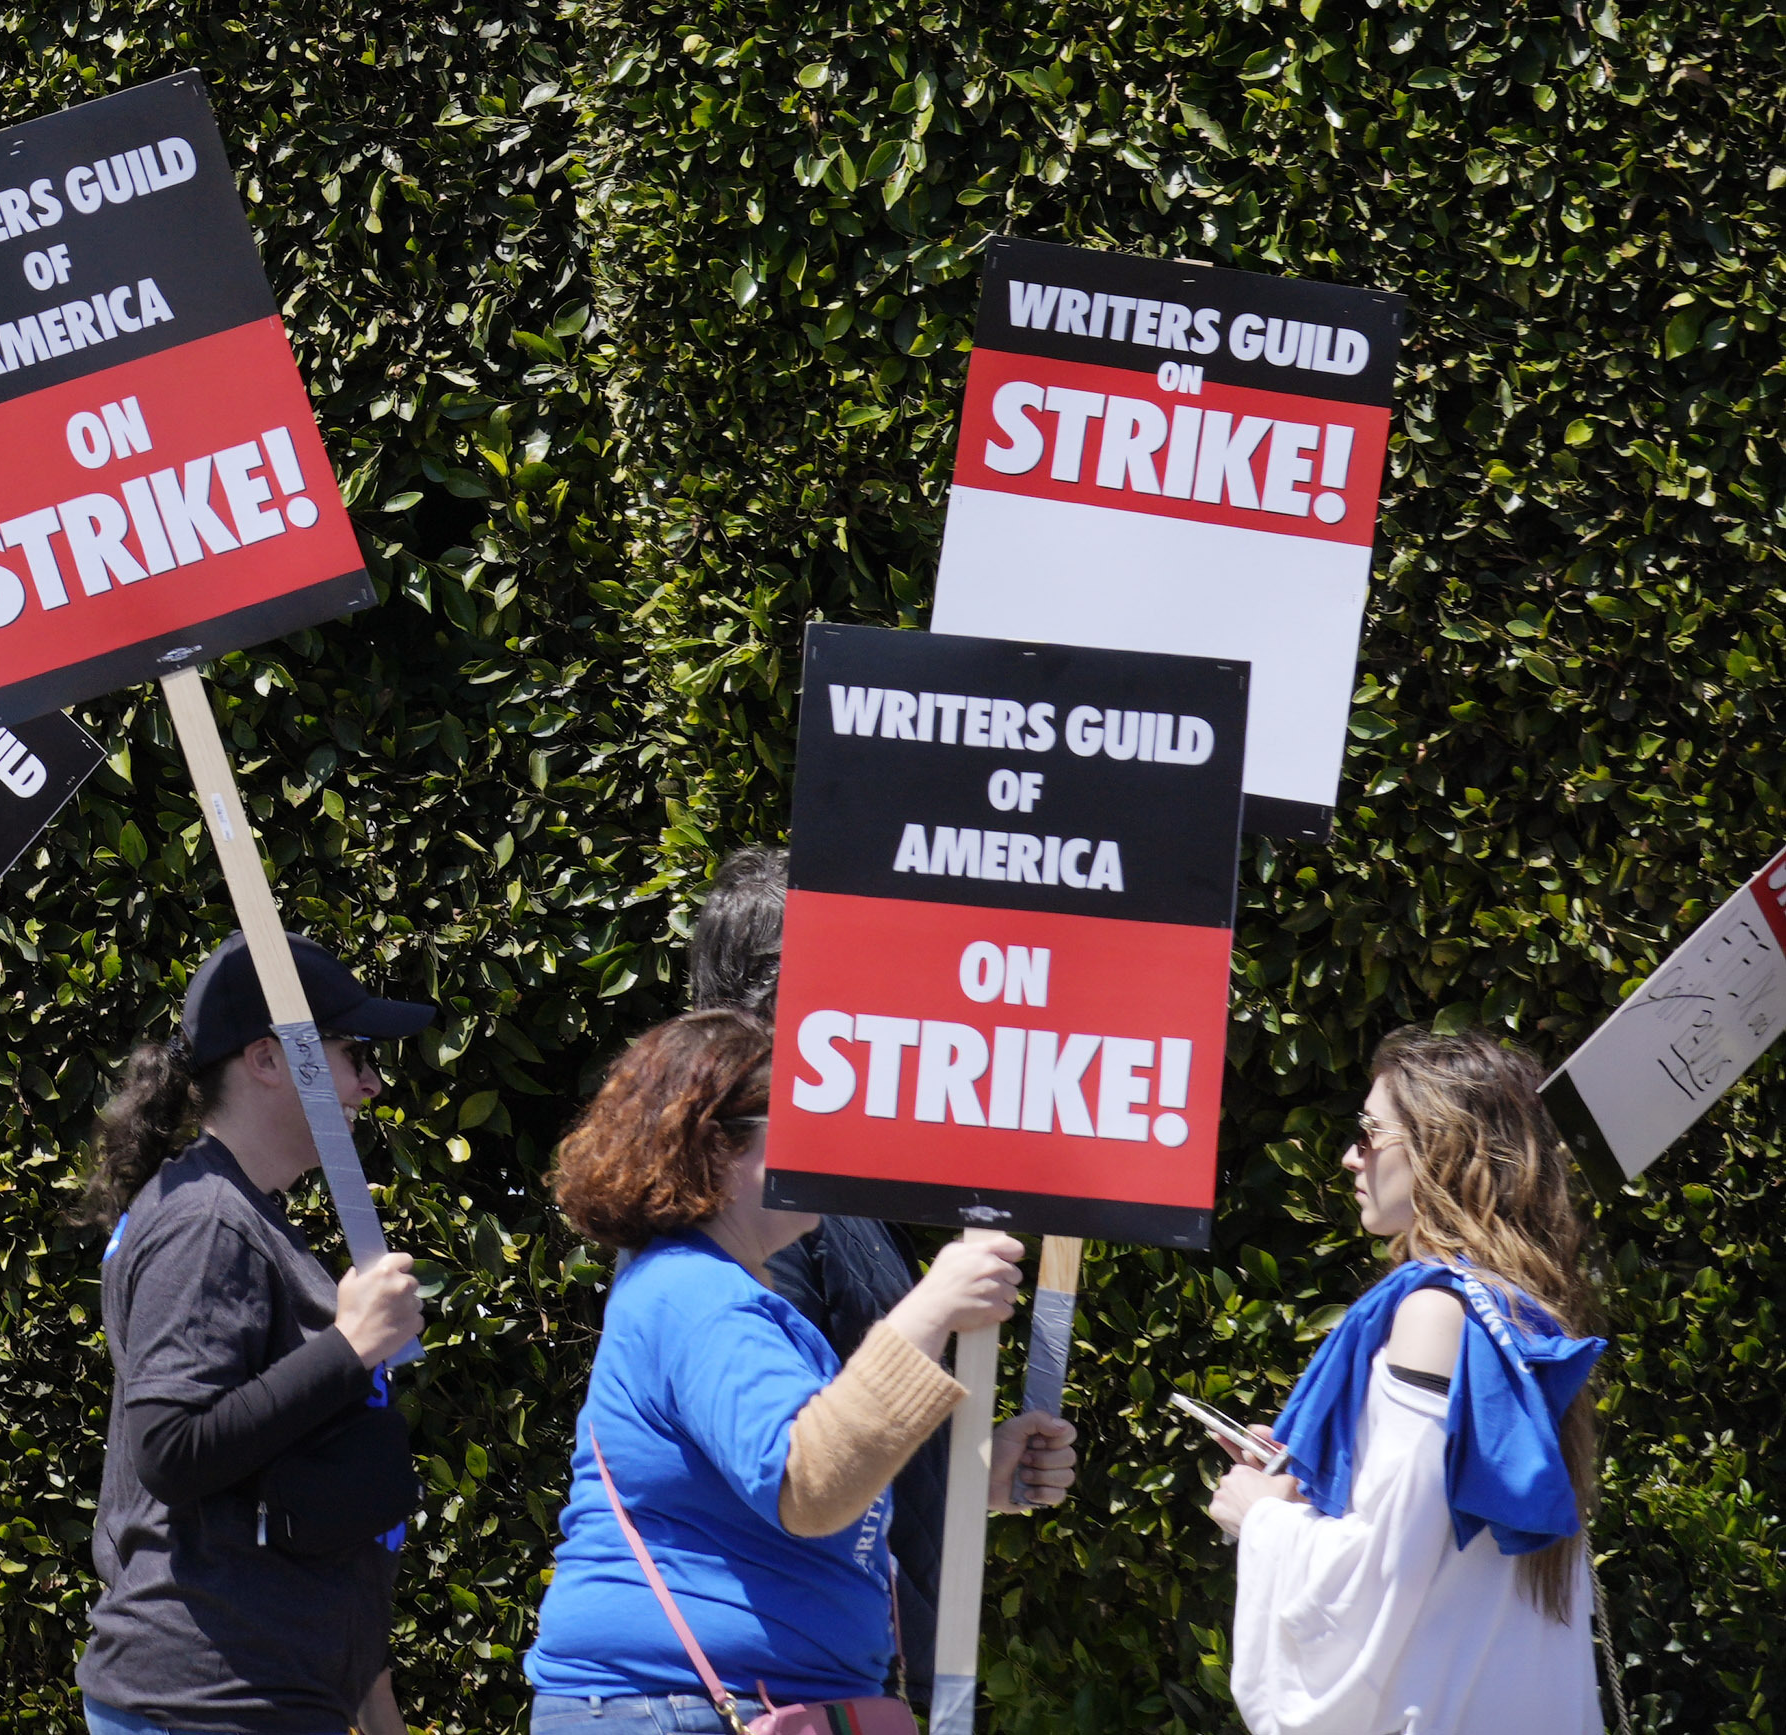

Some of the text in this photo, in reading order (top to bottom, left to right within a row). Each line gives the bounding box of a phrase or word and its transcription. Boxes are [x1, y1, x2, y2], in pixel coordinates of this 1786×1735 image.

[66, 138, 196, 213] GUILD
[24, 244, 71, 290] OF
[1010, 280, 1368, 375] WRITERS GUILD
[1158, 362, 1203, 394] ON
[67, 396, 152, 468] ON
[985, 382, 1354, 523] STRIKE!
[830, 685, 1213, 765] WRITERS GUILD
[989, 770, 1043, 812] OF
[894, 824, 1122, 891] AMERICA
[960, 941, 1050, 1007] ON
[793, 1010, 1192, 1147] STRIKE!
